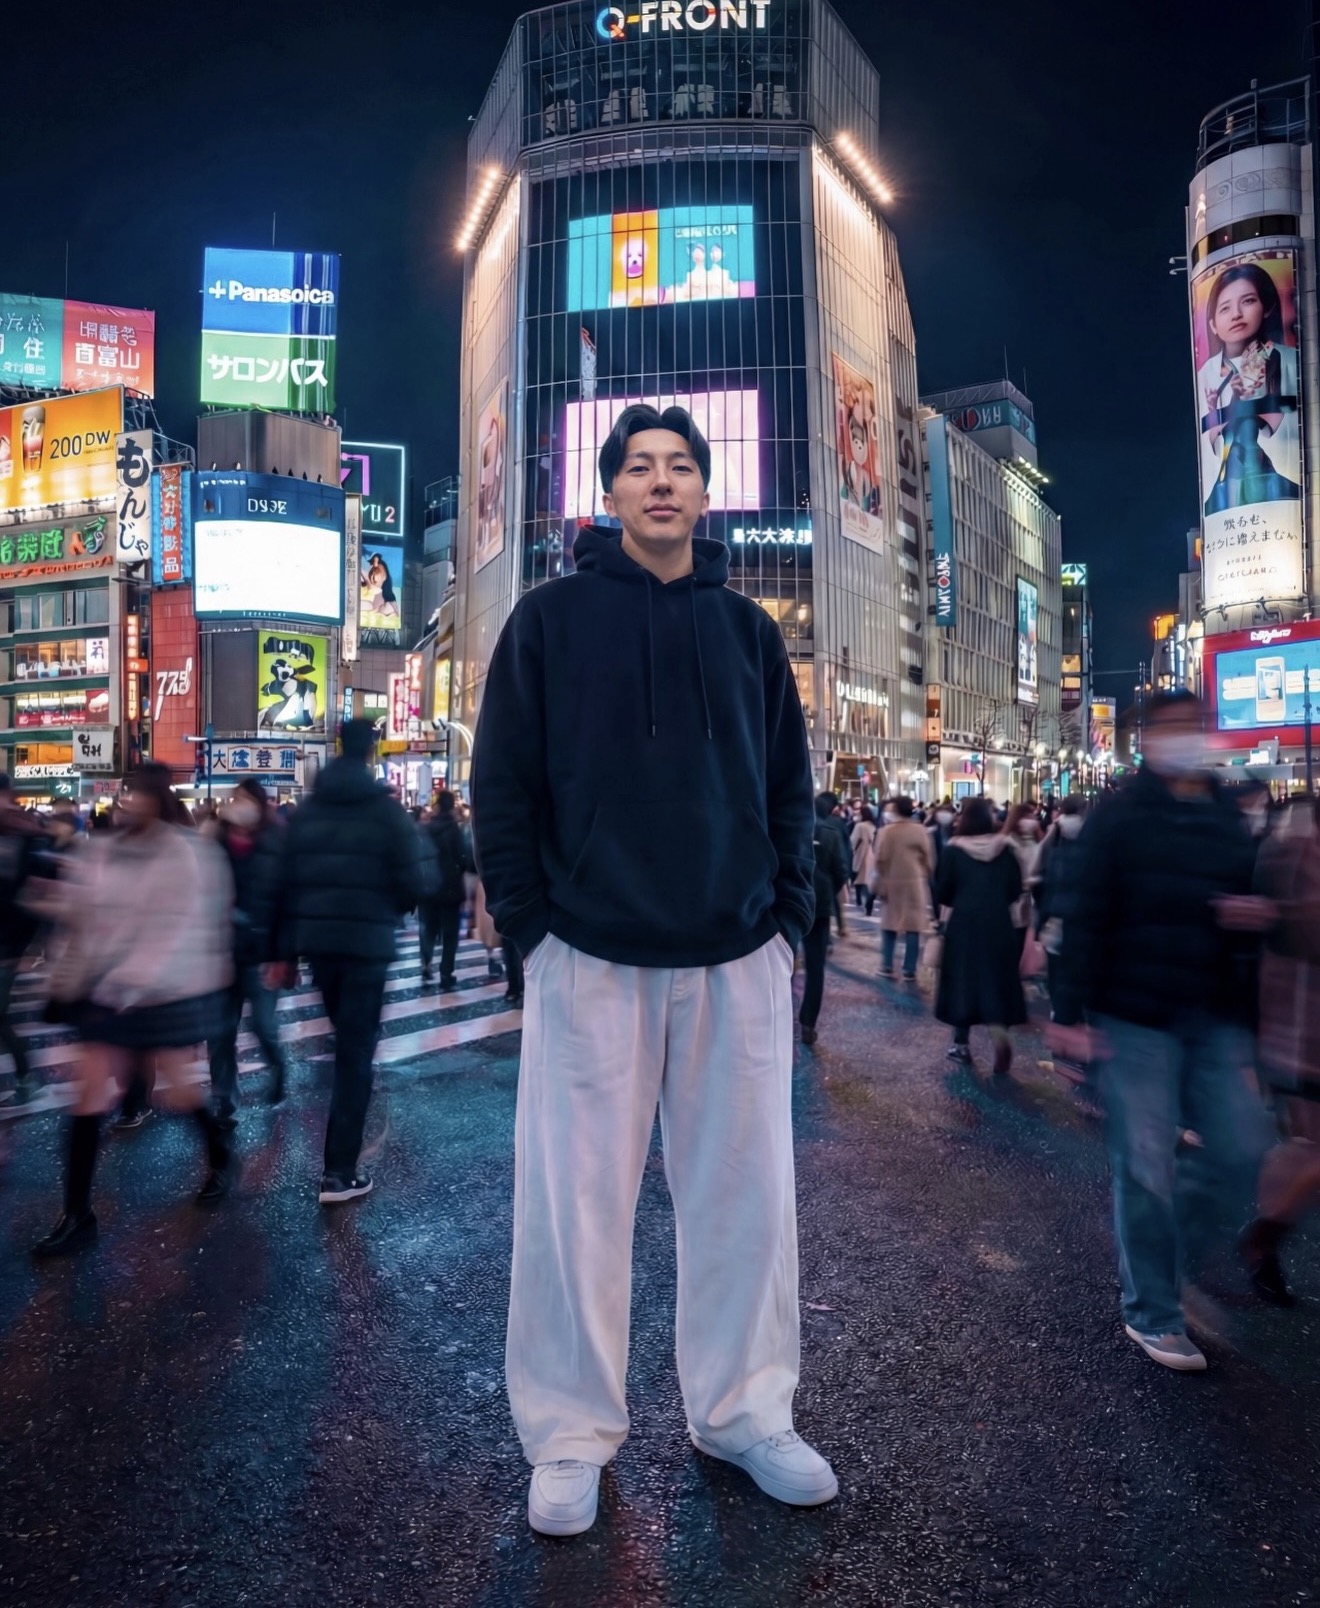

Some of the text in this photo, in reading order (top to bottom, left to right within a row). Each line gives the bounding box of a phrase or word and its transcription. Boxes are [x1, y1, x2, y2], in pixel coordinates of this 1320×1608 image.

[597, 0, 771, 38] Q-FRONT
[50, 430, 111, 459] 200 DW
[116, 437, 150, 556] もんじゃ
[384, 506, 395, 523] 2
